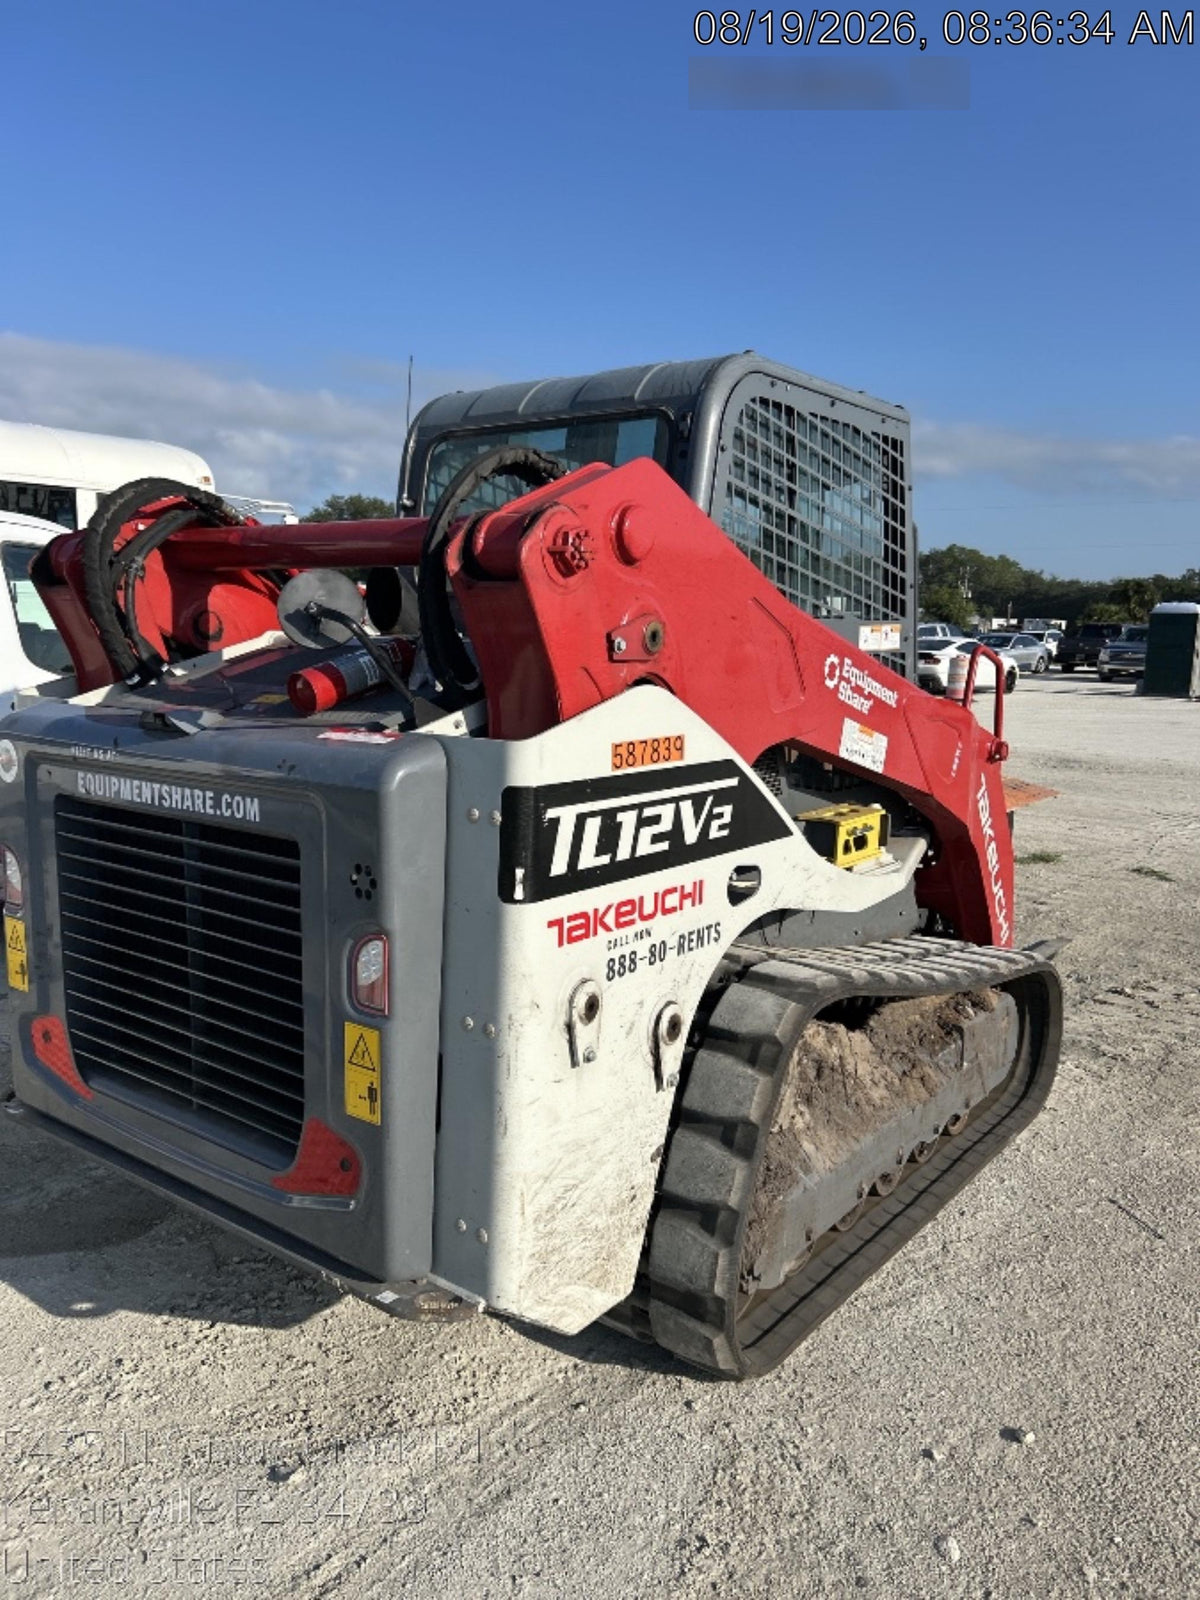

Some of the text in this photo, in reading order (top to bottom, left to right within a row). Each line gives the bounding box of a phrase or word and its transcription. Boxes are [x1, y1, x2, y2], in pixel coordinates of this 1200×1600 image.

[838, 680, 872, 715] Share
[842, 657, 898, 708] Equipment
[612, 735, 683, 769] 587839
[77, 771, 260, 822] EQUIPMENTSHARE.COM
[605, 921, 721, 982] 888-80-RENTS
